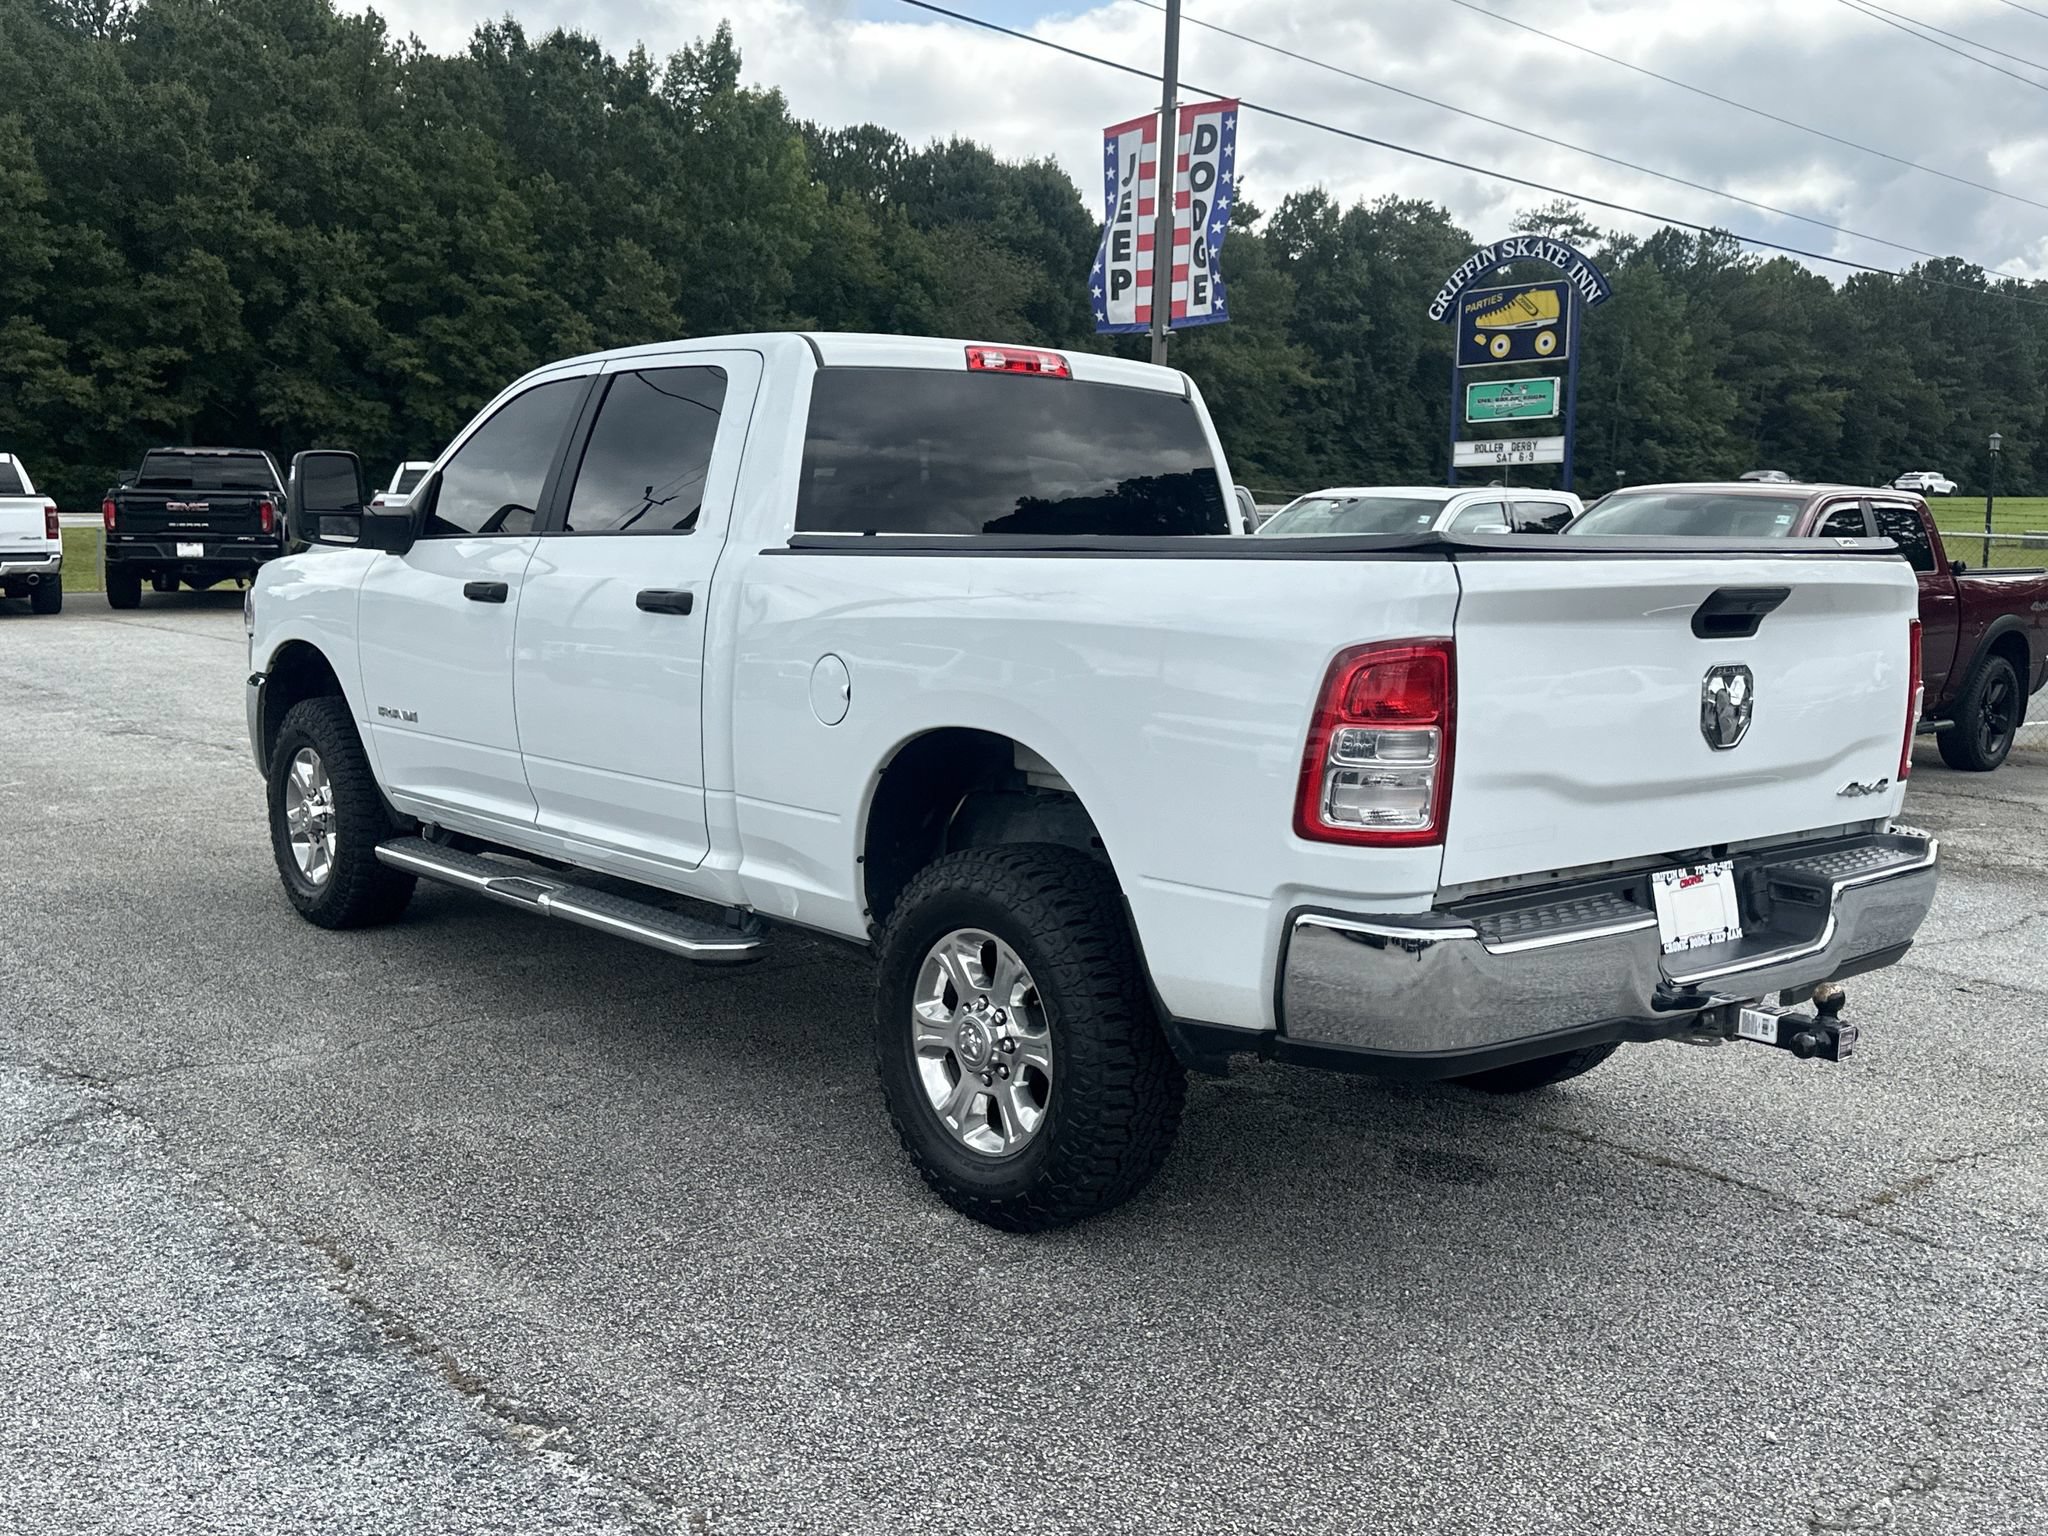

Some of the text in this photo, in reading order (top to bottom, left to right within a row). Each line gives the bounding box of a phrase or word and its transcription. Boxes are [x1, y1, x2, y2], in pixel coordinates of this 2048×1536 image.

[1190, 124, 1218, 306] DODGE
[1110, 153, 1137, 301] JEEP
[1428, 238, 1602, 322] GRIFFIN SKATE INN
[1465, 293, 1504, 314] PARTIES
[1474, 441, 1538, 454] ROLLER DERBY
[1496, 452, 1513, 463] SAT
[166, 502, 209, 511] GMC
